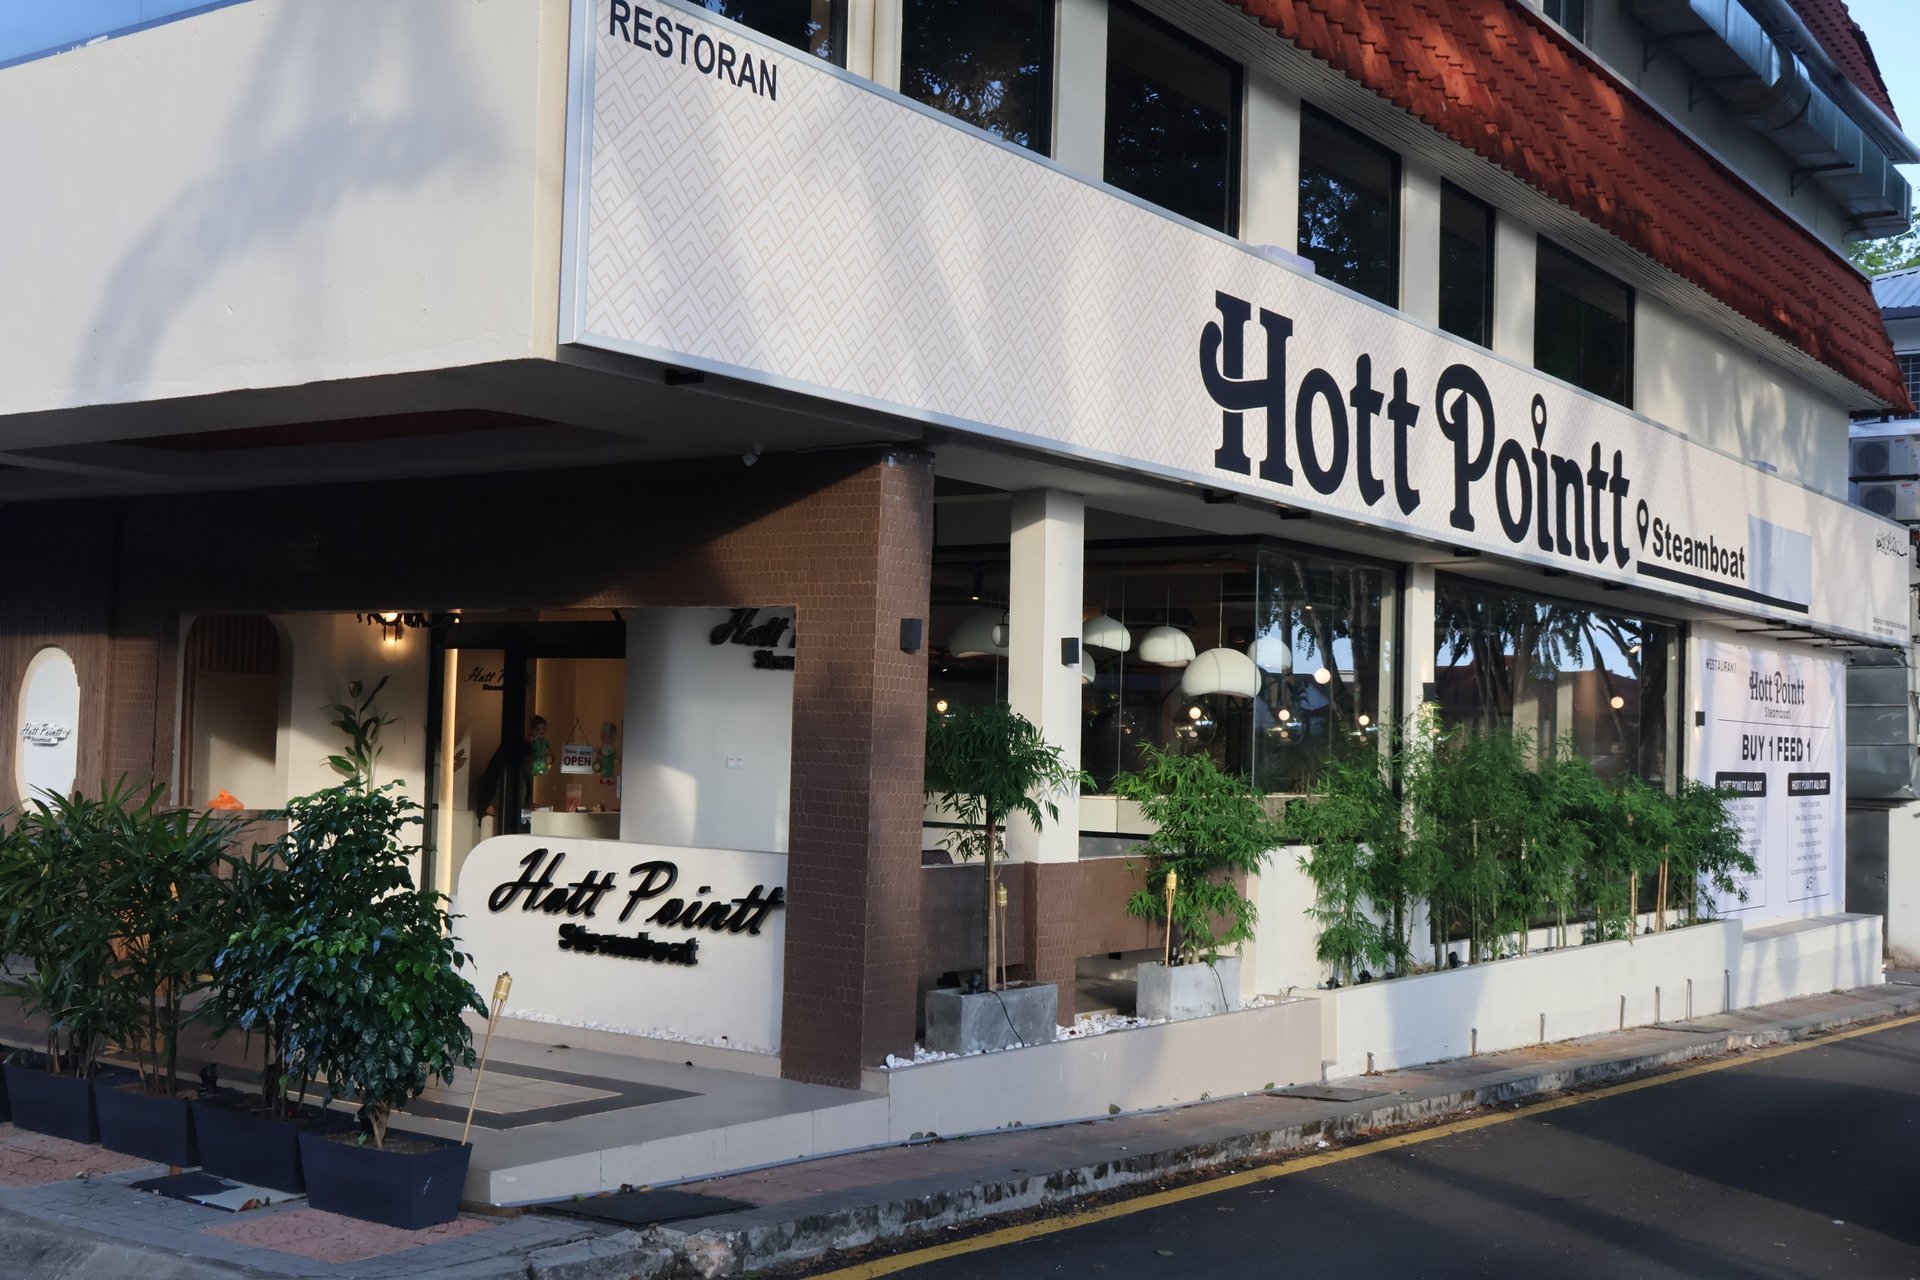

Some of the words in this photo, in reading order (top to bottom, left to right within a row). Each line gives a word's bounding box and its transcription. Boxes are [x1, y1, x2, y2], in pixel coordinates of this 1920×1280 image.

[609, 0, 777, 101] RESTORAN
[1199, 290, 1421, 517] Hott
[1435, 363, 1631, 570] Pointt
[1652, 517, 1746, 580] Steamboat
[1705, 658, 1737, 674] RESTAURANT
[1749, 671, 1773, 702] Hott
[1774, 671, 1805, 706] Pointt
[1764, 706, 1791, 720] Steamboat
[563, 756, 592, 767] OPEN
[1742, 734, 1765, 761] BUY
[1768, 736, 1773, 762] 1
[1777, 736, 1804, 762] FEED
[1806, 738, 1811, 762] 1
[488, 848, 619, 918] Hott
[618, 860, 786, 936] Pointt
